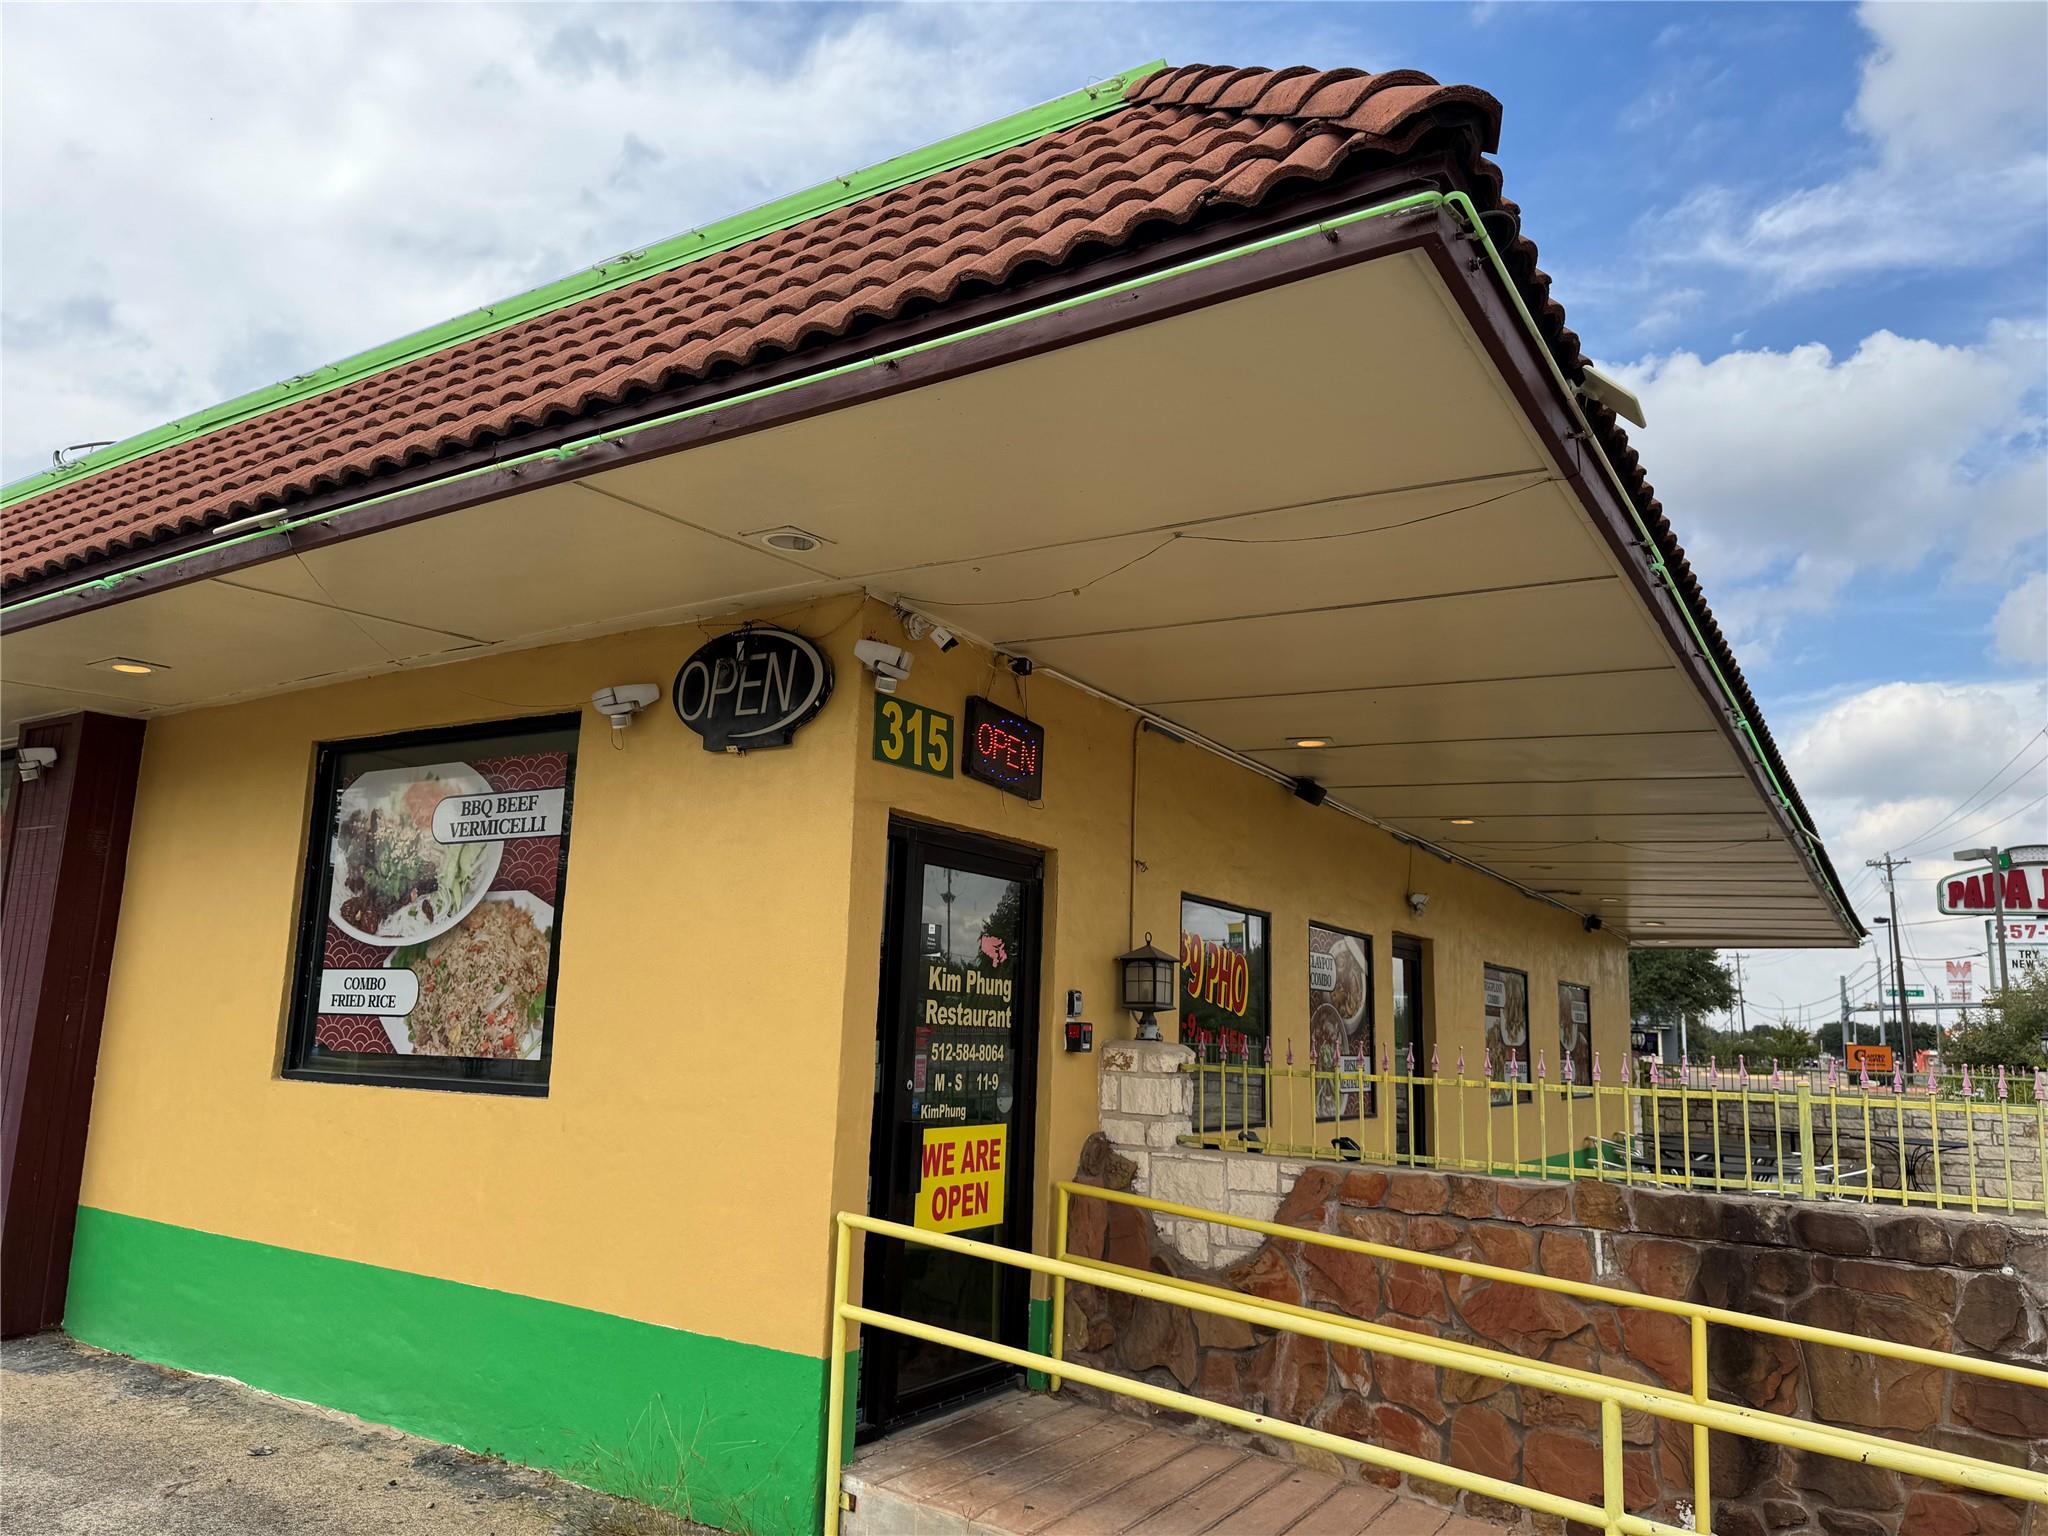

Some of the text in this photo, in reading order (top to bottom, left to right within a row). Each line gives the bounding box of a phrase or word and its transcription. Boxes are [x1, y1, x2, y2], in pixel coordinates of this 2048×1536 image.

[677, 648, 798, 722] OPEN
[880, 700, 949, 772] 315
[976, 722, 1036, 776] OPEN
[460, 794, 540, 818] BBQ BEEF
[449, 815, 548, 839] VERMICELLI
[2019, 950, 2039, 959] TRY
[343, 977, 386, 991] COMBO
[928, 965, 1012, 1003] Kim Phung
[1180, 929, 1249, 1016] $9 PHO
[1311, 971, 1332, 987] COMBO
[331, 994, 396, 1009] FRIED RICE
[925, 999, 1012, 1029] Restaurant
[931, 1042, 1004, 1062] 512-584-8064
[935, 1073, 945, 1092] M
[954, 1072, 963, 1091] S
[976, 1072, 999, 1091] 11-9
[920, 1103, 967, 1121] KimPhung
[922, 1138, 1001, 1178] WE ARE
[931, 1181, 989, 1223] OPEN
